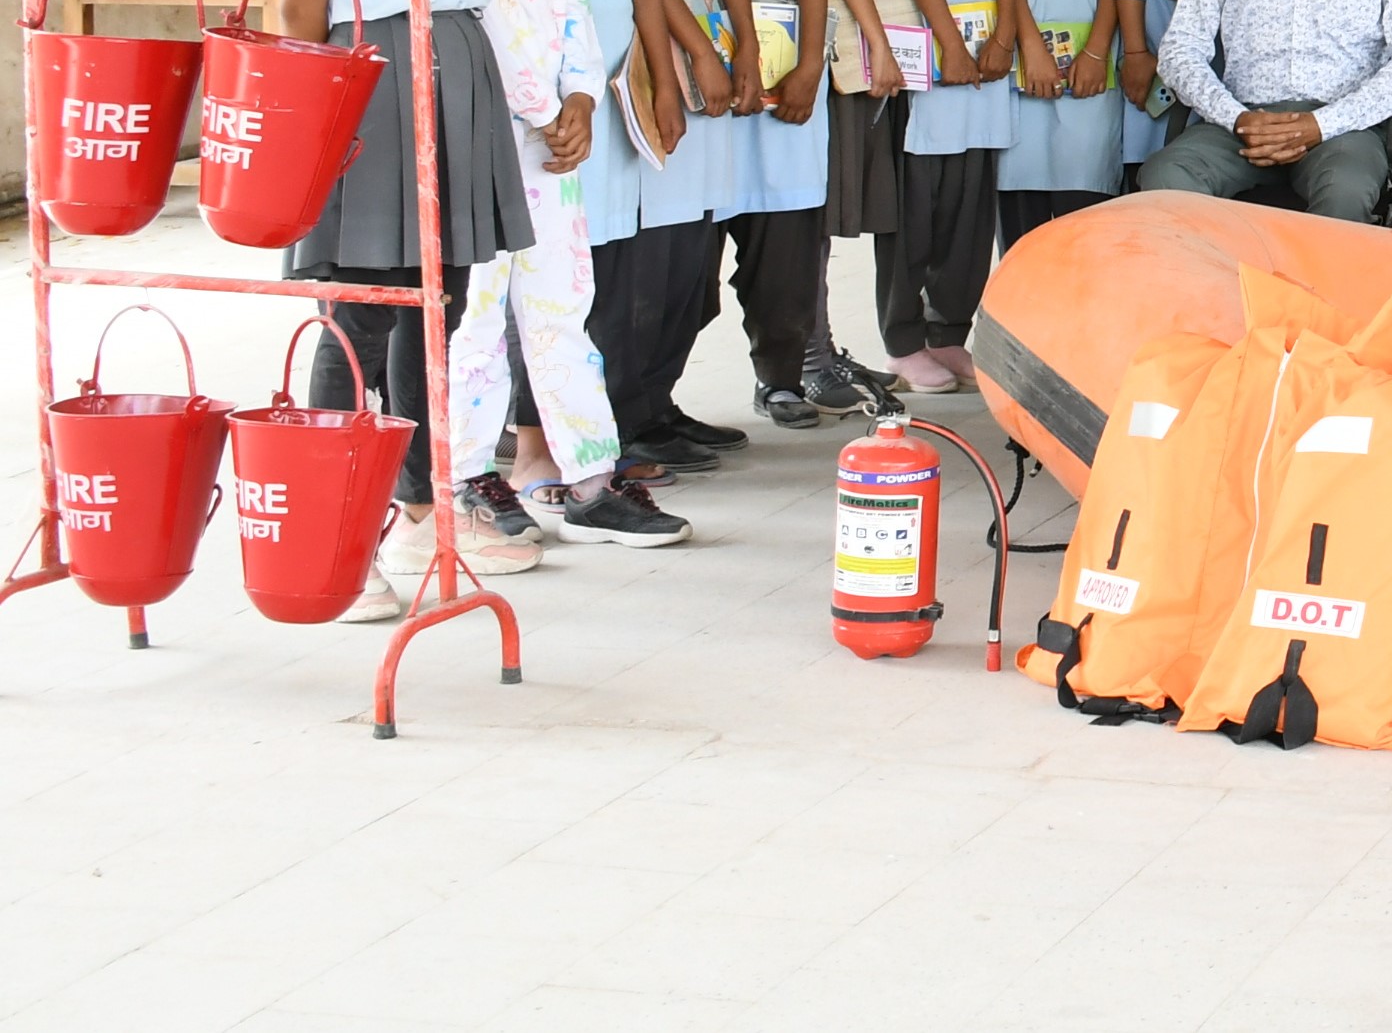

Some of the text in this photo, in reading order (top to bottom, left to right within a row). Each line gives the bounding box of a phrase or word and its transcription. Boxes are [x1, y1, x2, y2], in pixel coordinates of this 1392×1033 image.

[62, 98, 151, 134] FIRE
[65, 137, 141, 162] आग
[201, 136, 253, 170] आग
[876, 471, 931, 484] POWDER
[1082, 577, 1129, 609] APPROVED
[1271, 597, 1353, 628] D.O.T
